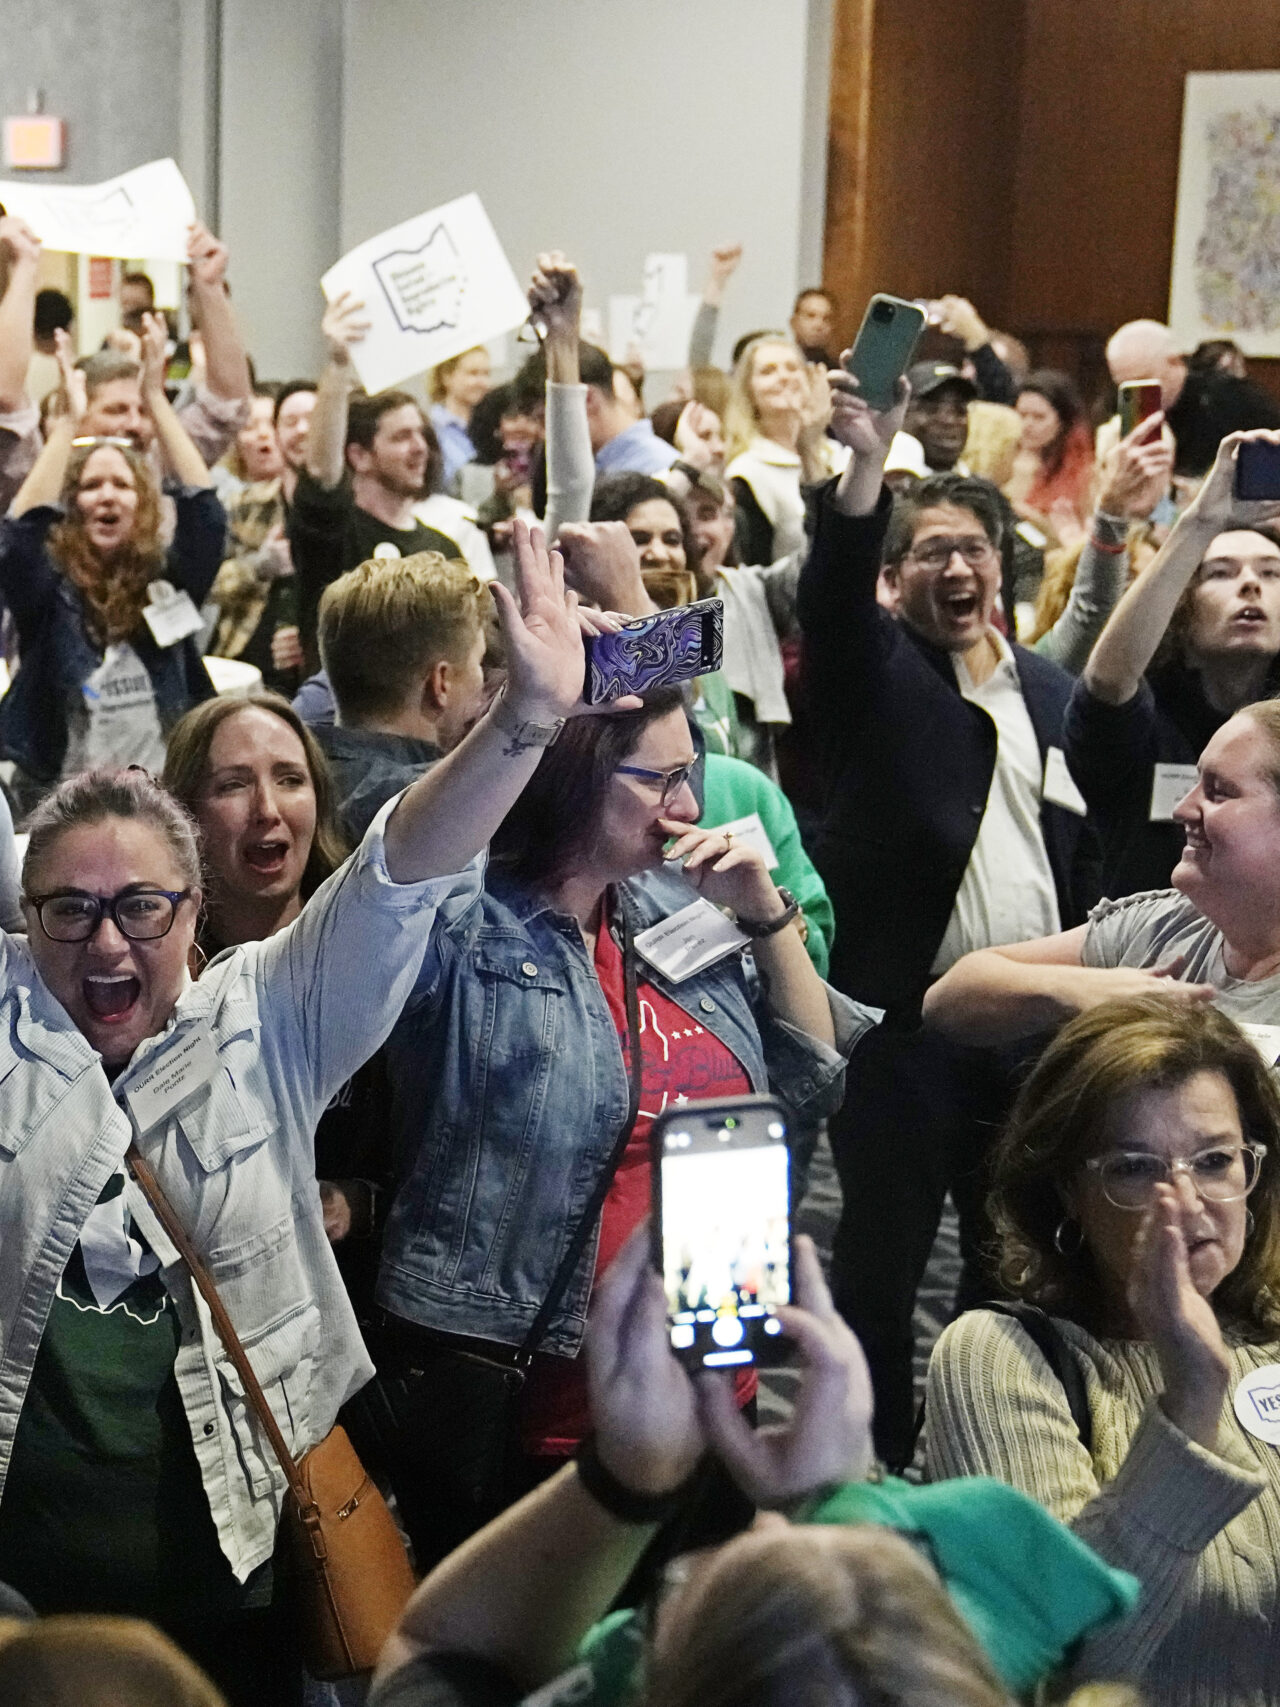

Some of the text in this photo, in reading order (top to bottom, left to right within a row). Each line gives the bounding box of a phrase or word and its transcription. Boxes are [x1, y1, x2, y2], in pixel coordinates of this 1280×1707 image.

[134, 1036, 201, 1093] OURR Election Night
